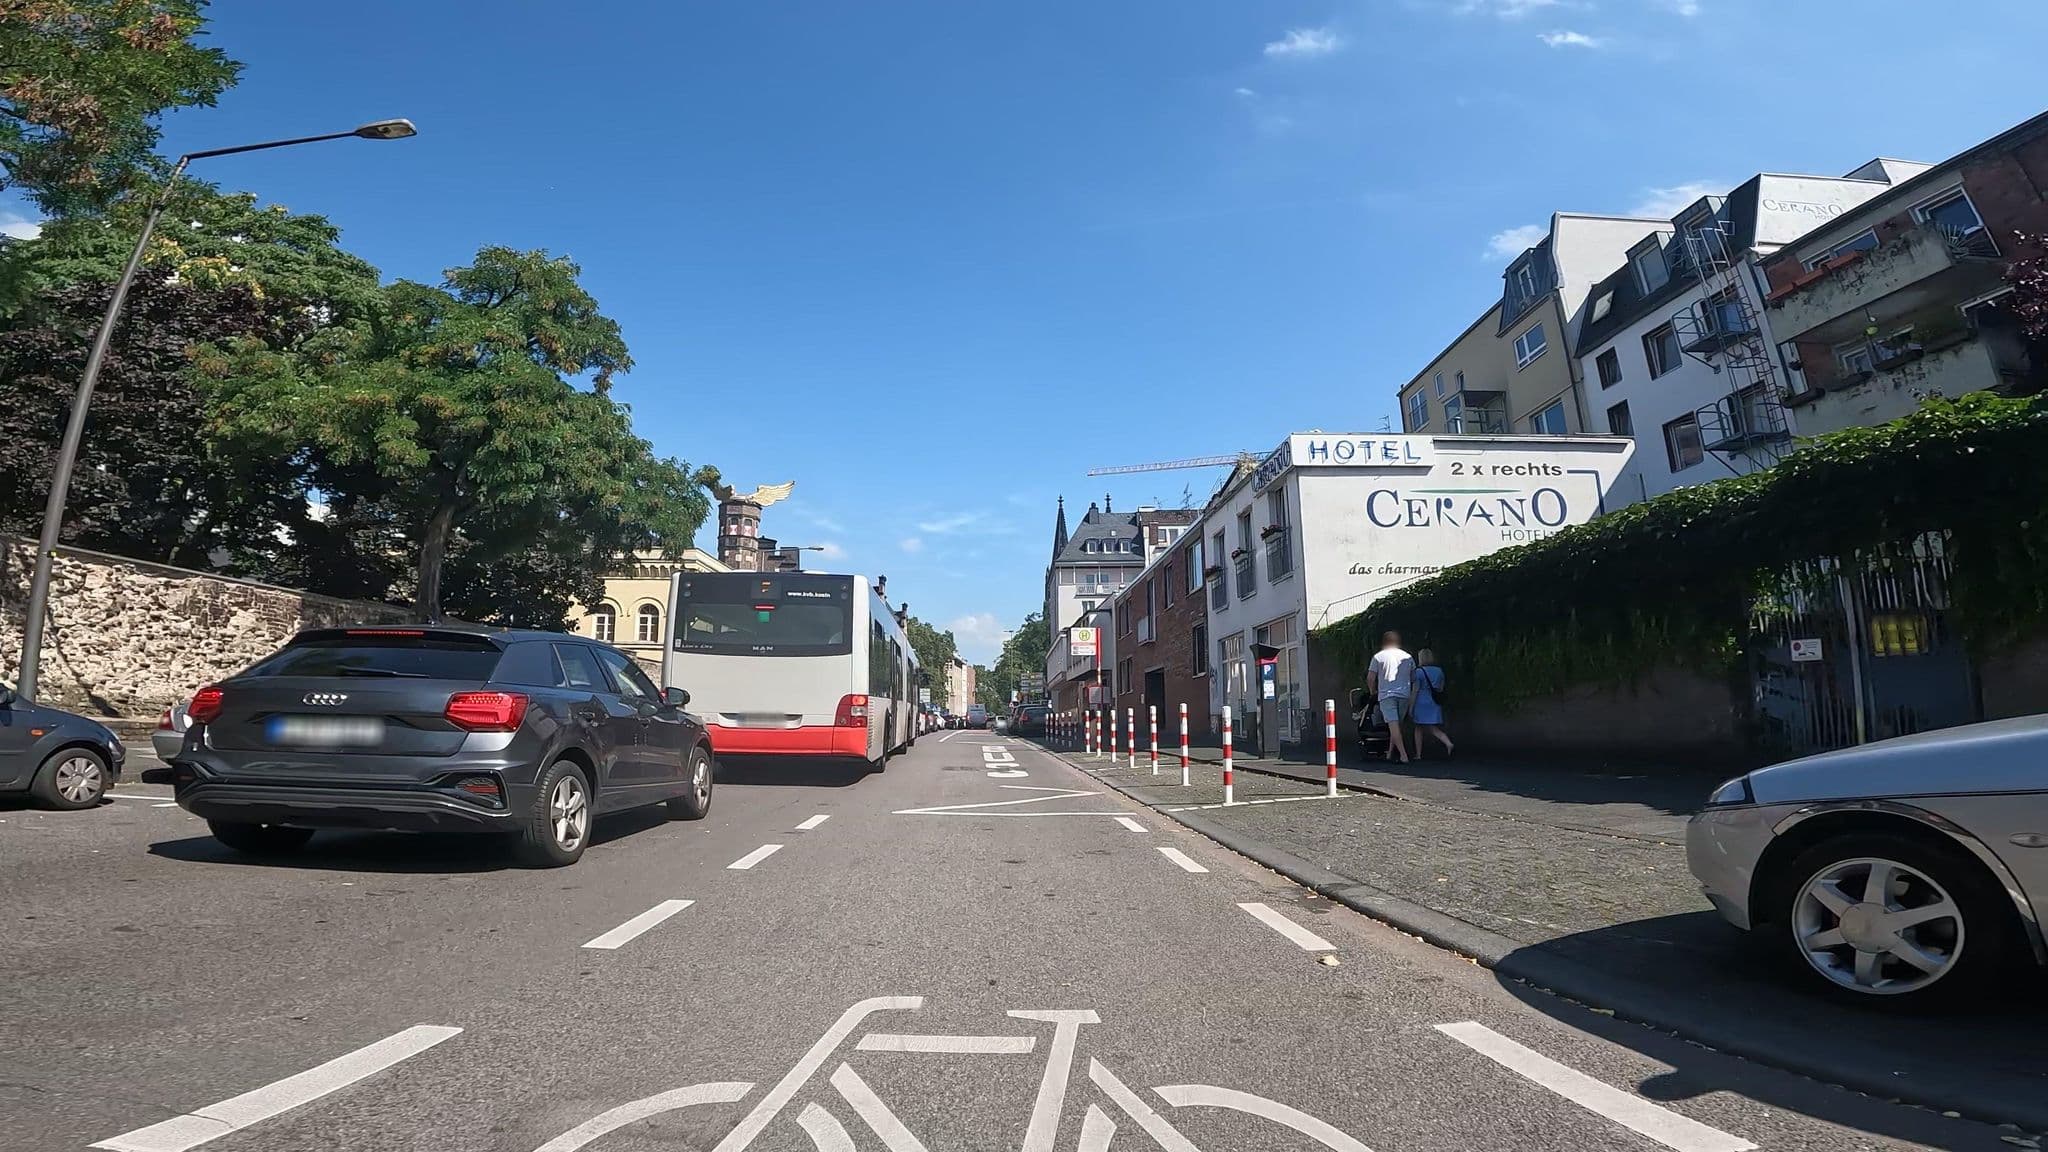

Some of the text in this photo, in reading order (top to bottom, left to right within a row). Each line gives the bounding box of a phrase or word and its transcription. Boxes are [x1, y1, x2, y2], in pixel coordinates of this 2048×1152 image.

[1309, 440, 1421, 461] HOTEL
[1451, 462, 1562, 476] 2 x rechts
[1366, 488, 1567, 528] CERANO
[1349, 562, 1373, 575] das
[1263, 664, 1271, 675] P
